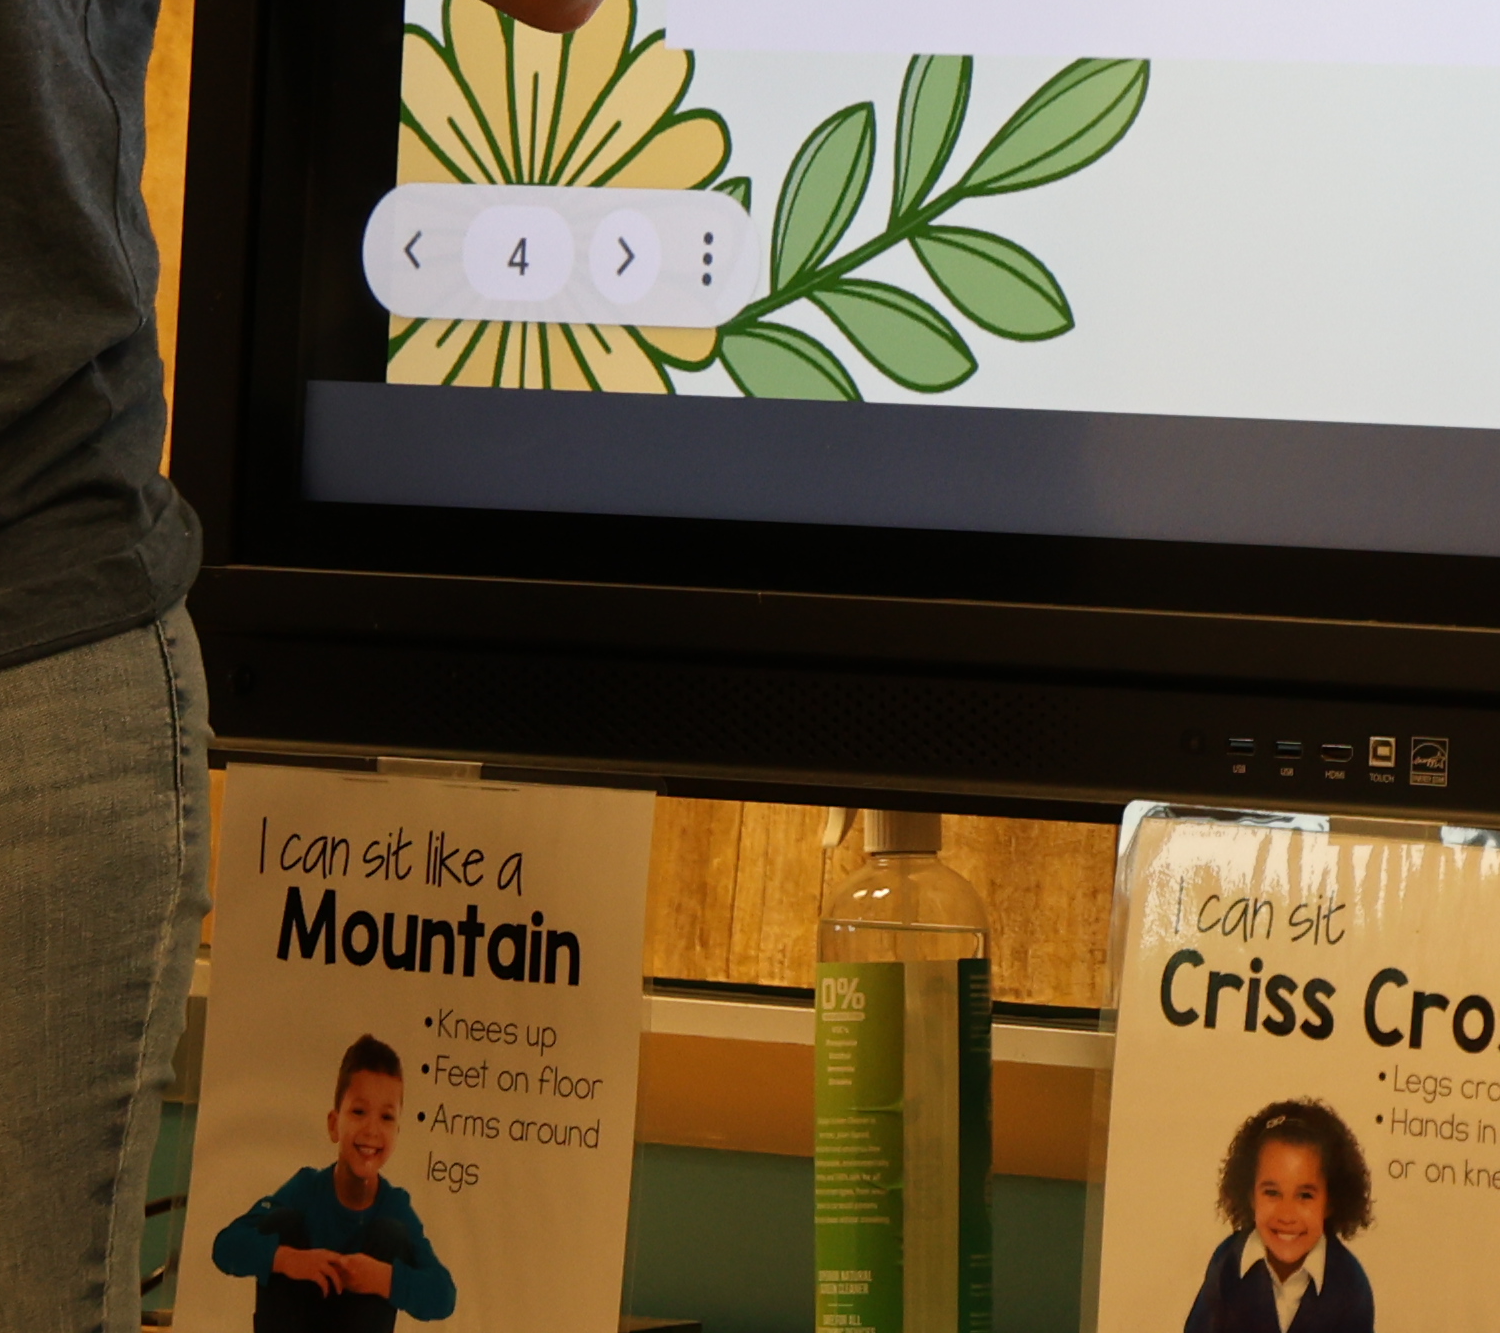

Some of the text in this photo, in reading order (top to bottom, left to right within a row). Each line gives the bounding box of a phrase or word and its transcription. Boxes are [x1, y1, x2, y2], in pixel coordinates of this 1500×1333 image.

[507, 237, 530, 277] 4
[1325, 770, 1345, 780] HDMI
[1369, 772, 1395, 783] TOUCH
[259, 816, 524, 896] I can sit like a
[1175, 876, 1345, 945] I can sit
[276, 885, 581, 986] Mountain
[822, 978, 865, 1010] 0%
[1160, 948, 1337, 1041] Criss
[437, 1008, 557, 1057] Knees up
[434, 1055, 603, 1101] Feet on floor
[1394, 1065, 1452, 1103] Legs
[430, 1104, 600, 1149] Arms around
[1390, 1108, 1469, 1143] Hands
[1477, 1120, 1497, 1144] in
[426, 1151, 480, 1193] legs
[1388, 1156, 1415, 1178] or
[1425, 1160, 1456, 1184] on
